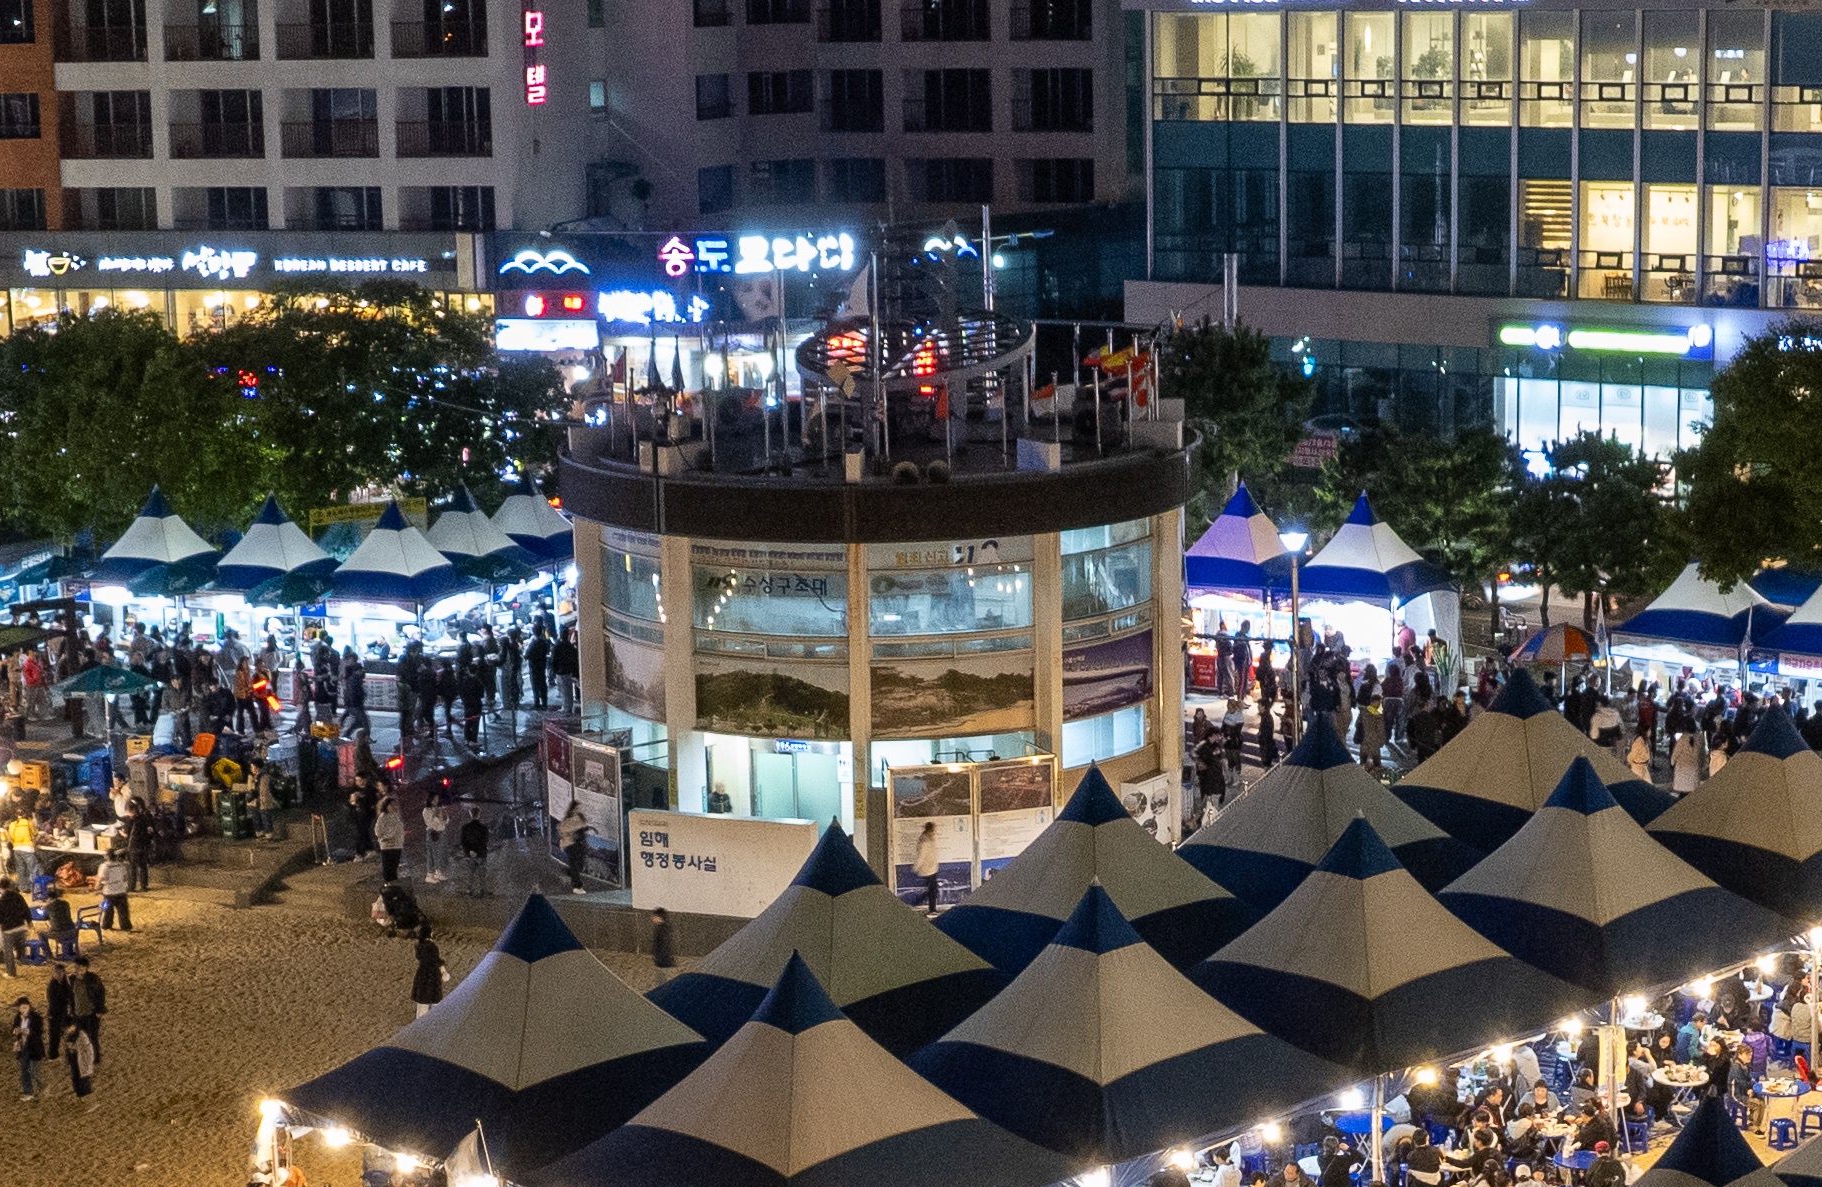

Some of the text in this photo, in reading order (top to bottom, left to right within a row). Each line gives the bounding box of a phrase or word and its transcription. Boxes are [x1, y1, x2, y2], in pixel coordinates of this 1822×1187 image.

[525, 11, 546, 106] 모텔
[274, 259, 327, 272] KOREAN
[391, 259, 427, 272] CAFE
[659, 236, 729, 276] 송도
[744, 575, 827, 596] 수상구조대
[639, 831, 669, 848] 임해
[640, 851, 717, 872] 행정봉사실
